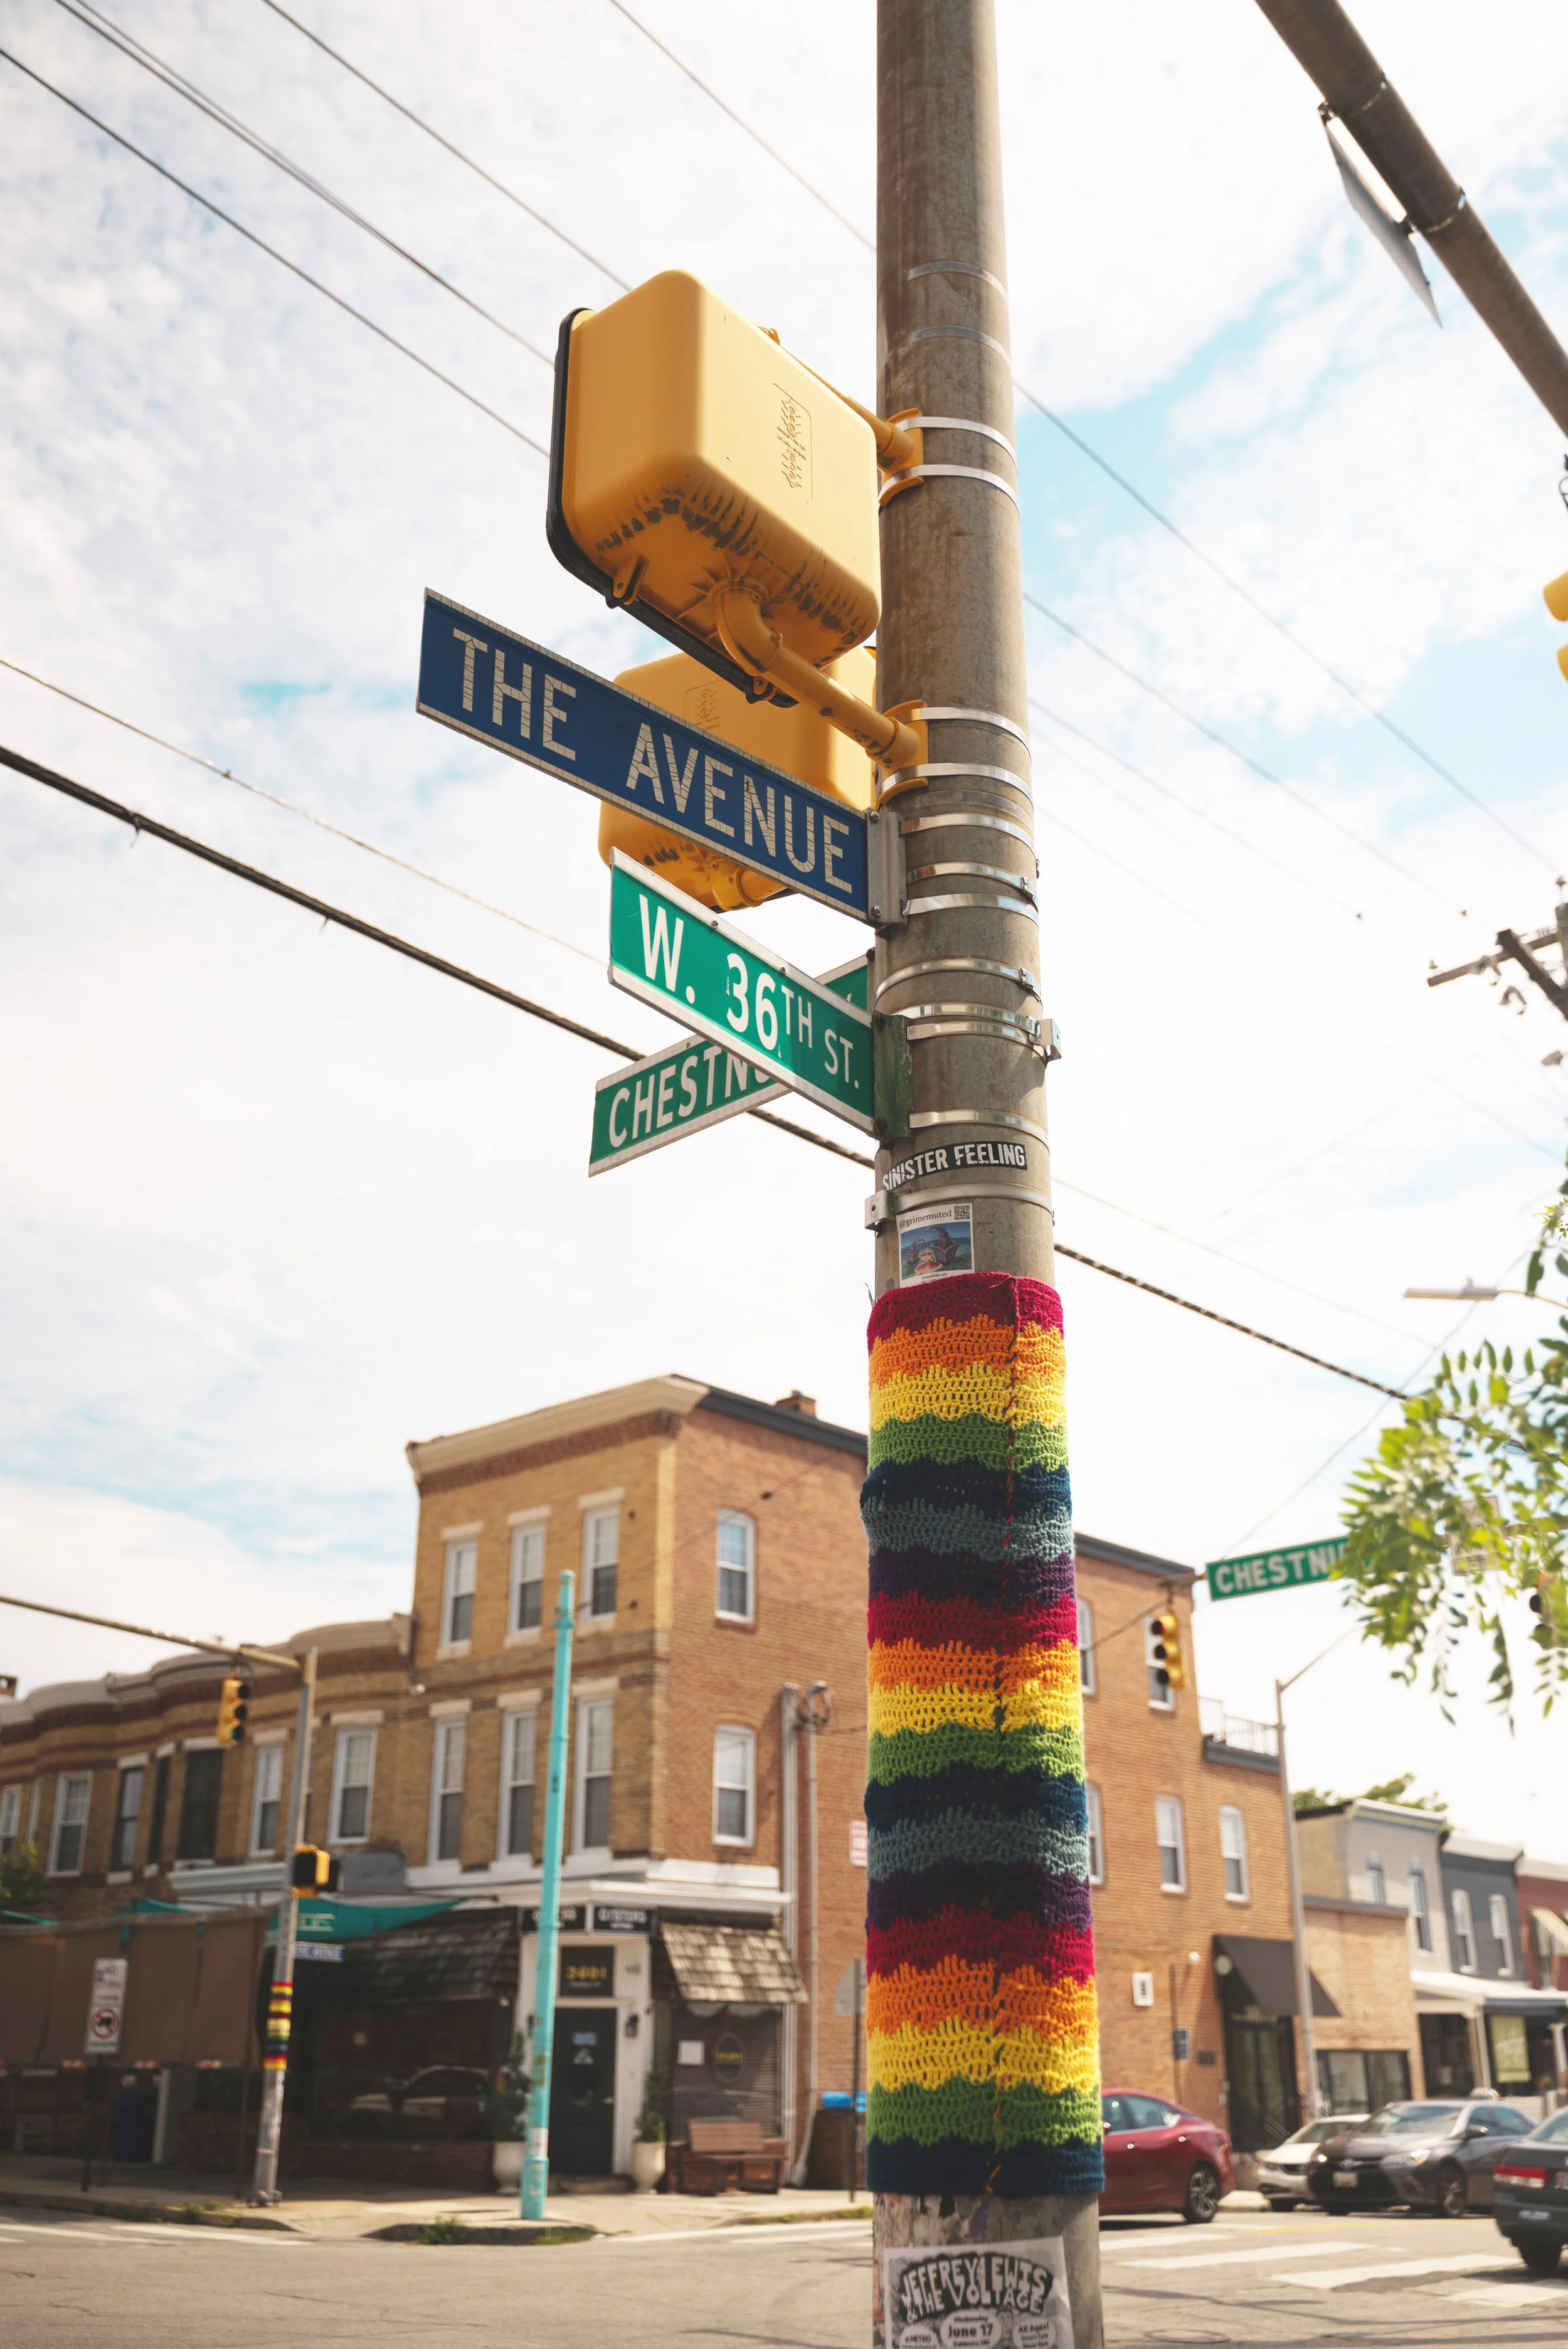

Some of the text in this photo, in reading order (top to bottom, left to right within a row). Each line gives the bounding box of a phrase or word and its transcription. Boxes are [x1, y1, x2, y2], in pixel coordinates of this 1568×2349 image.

[453, 627, 852, 894] THE AVENUE
[638, 893, 860, 1090] W. 36TH ST.
[882, 1143, 1025, 1191] SINISTER FEELING
[899, 1209, 952, 1228] @grimemuted
[901, 2256, 1047, 2307] JEFFREY LEWIS
[948, 2322, 993, 2339] June 17
[1019, 2323, 1028, 2333] All
